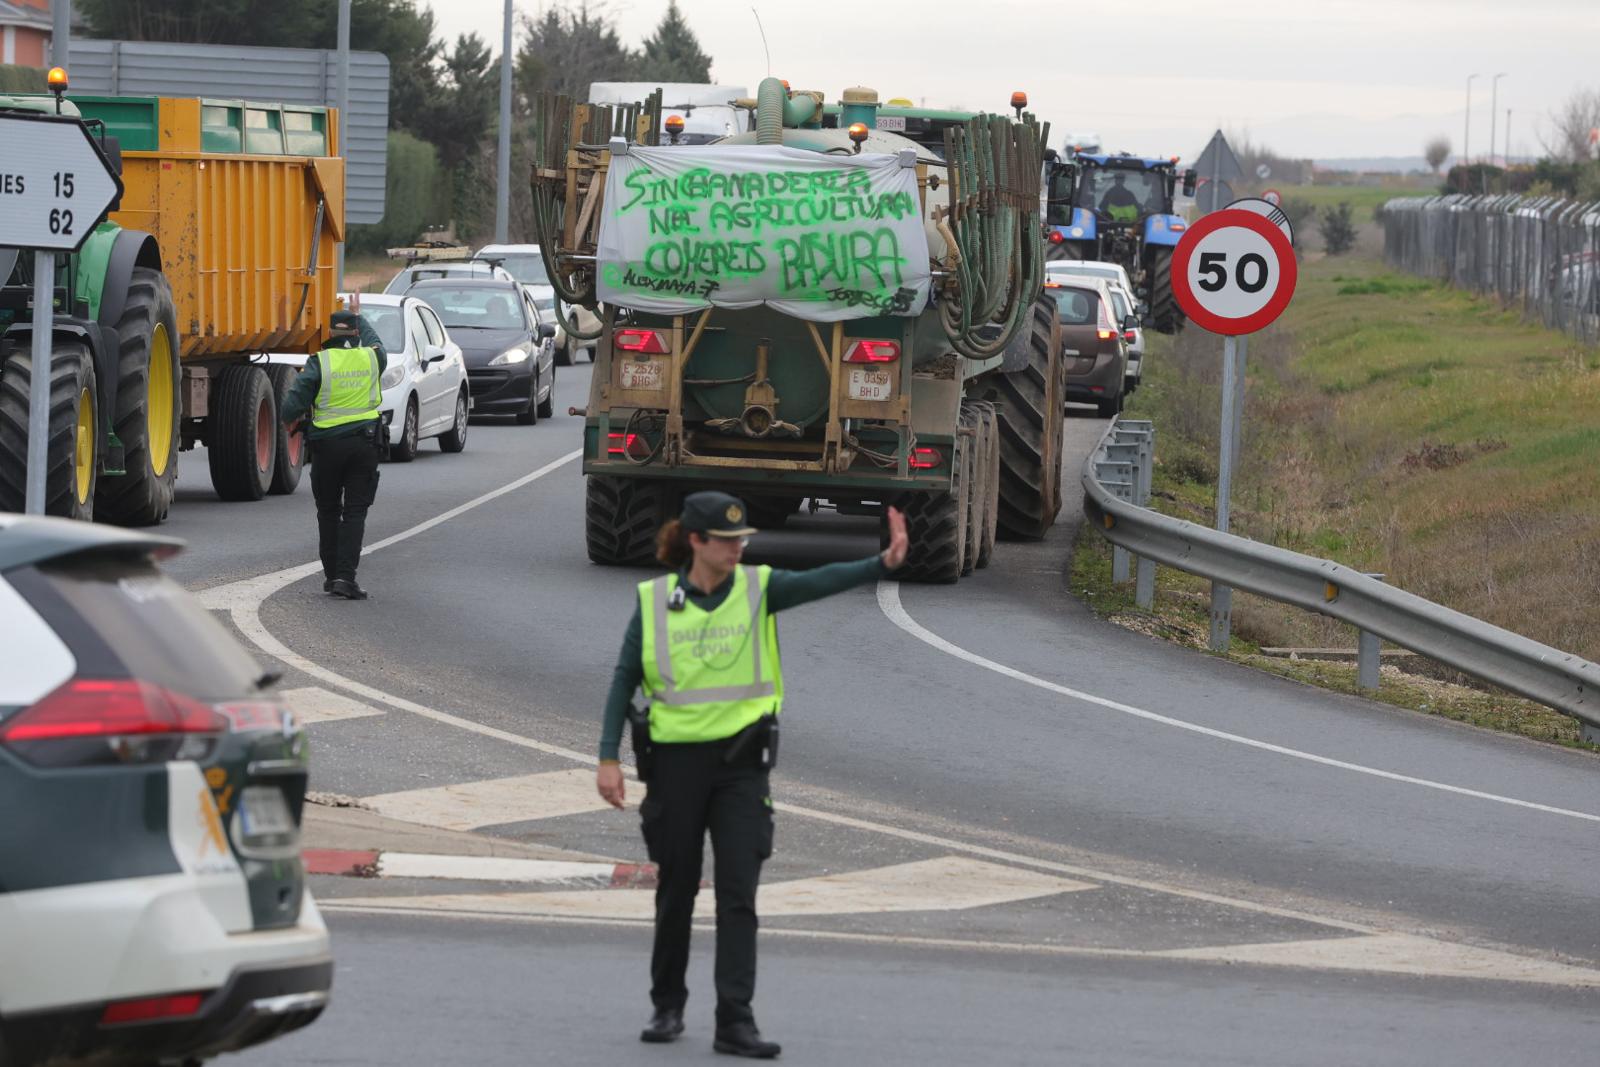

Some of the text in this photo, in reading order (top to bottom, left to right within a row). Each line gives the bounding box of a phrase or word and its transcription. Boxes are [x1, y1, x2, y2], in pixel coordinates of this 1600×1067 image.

[0, 172, 74, 198] ES 15
[621, 168, 678, 211] SIN
[49, 208, 73, 235] 62
[710, 190, 916, 231] AGRICULTURA
[774, 227, 908, 290] BASURA
[1198, 252, 1268, 293] 50
[853, 371, 859, 383] E
[672, 623, 747, 645] GUARDIA
